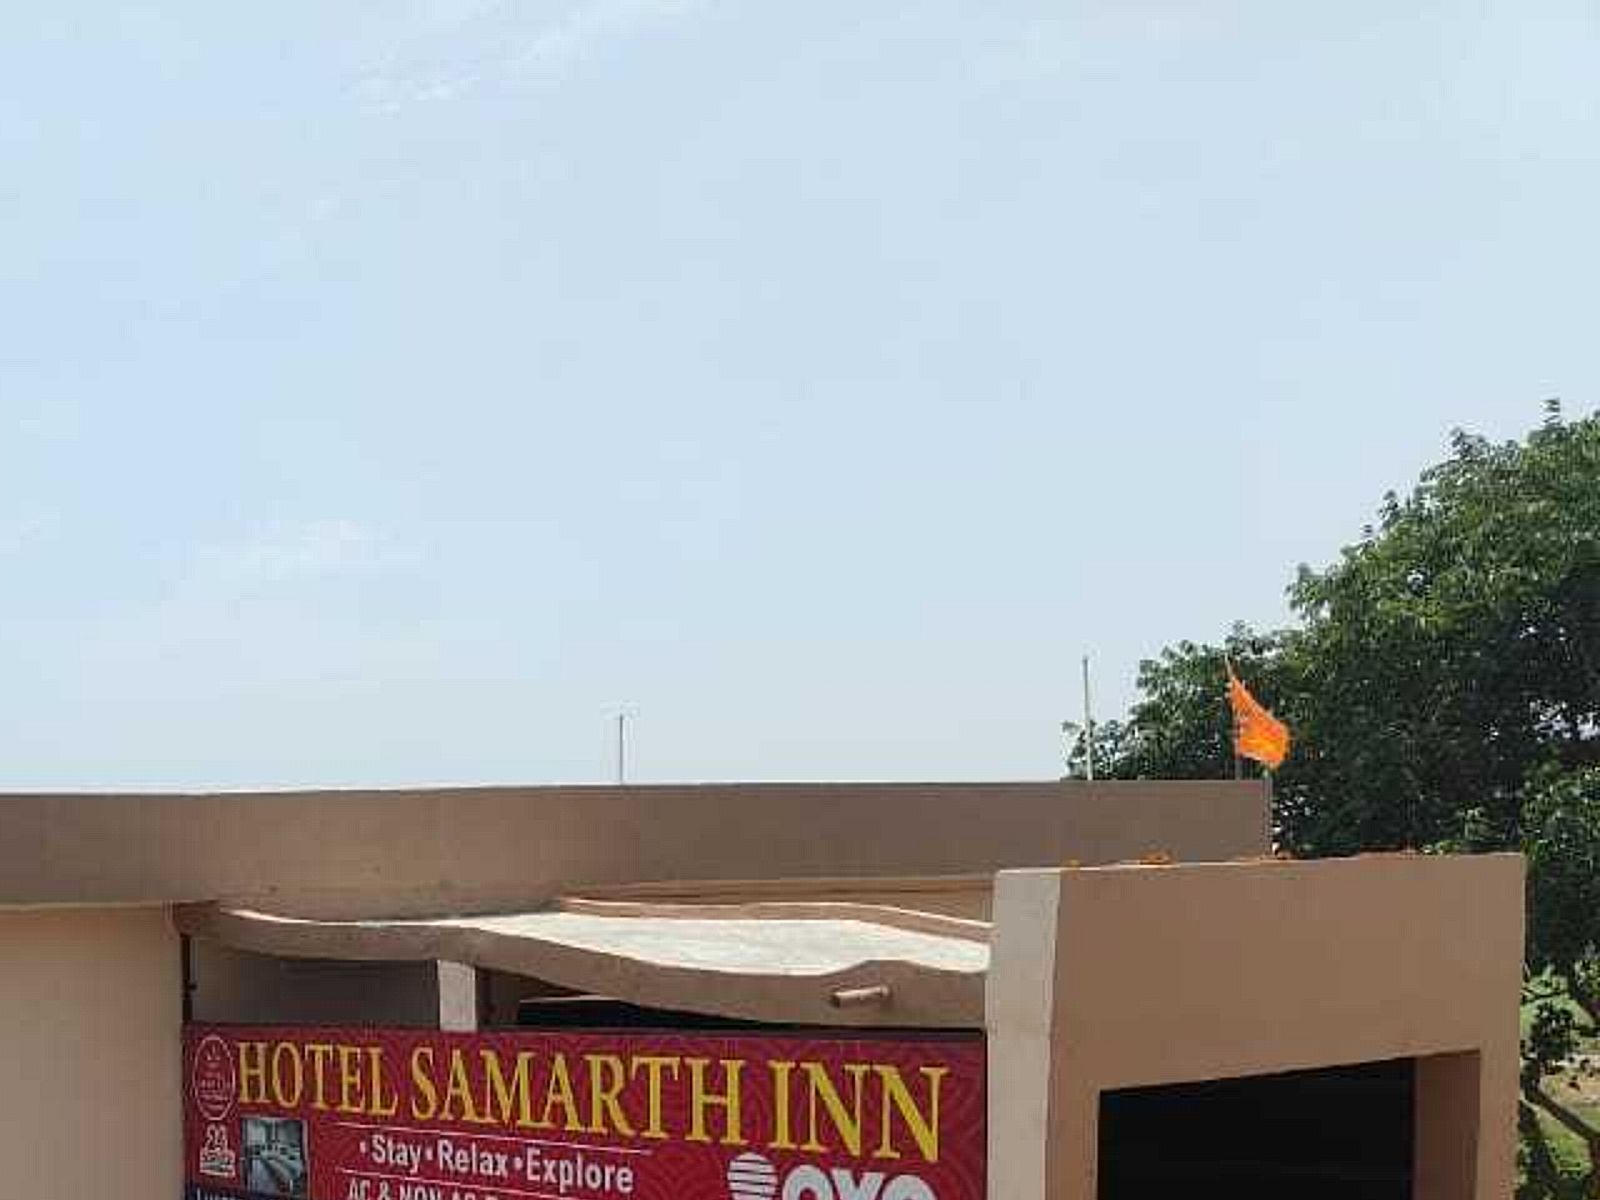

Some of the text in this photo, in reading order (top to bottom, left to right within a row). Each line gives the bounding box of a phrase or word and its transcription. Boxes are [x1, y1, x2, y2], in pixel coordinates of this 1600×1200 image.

[236, 1041, 399, 1117] HOTEL
[411, 1046, 749, 1147] SAMARTH
[768, 1060, 954, 1162] INN
[371, 1134, 635, 1193] Stay Relax Explore
